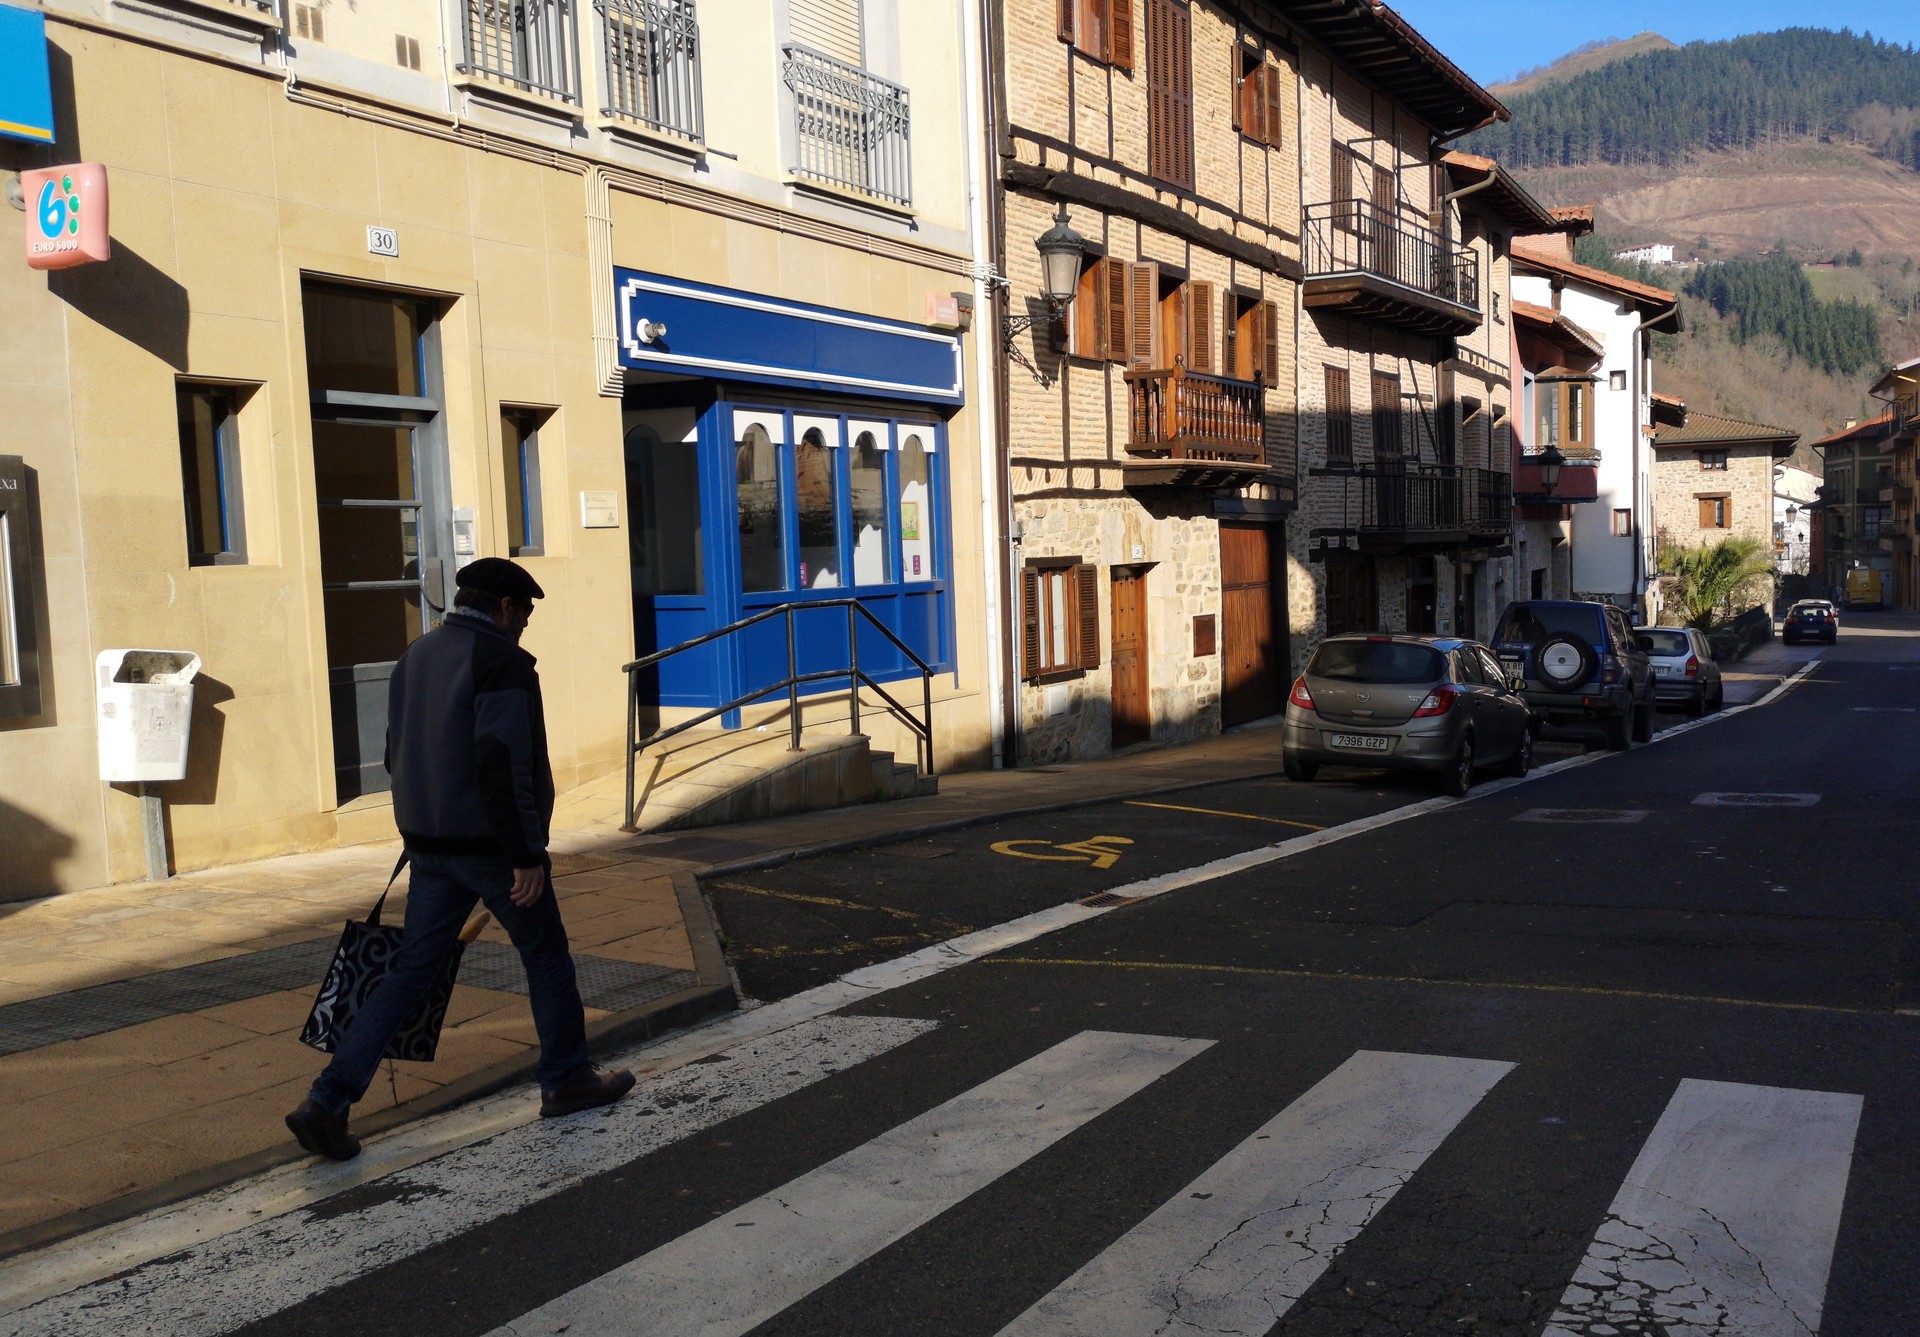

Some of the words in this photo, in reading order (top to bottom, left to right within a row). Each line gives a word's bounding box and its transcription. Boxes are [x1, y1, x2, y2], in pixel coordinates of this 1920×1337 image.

[38, 179, 67, 239] 6
[33, 241, 55, 253] EURO
[56, 239, 78, 252] 6000
[374, 231, 392, 250] 30
[1338, 735, 1363, 747] 7396
[1365, 737, 1385, 748] GZP
